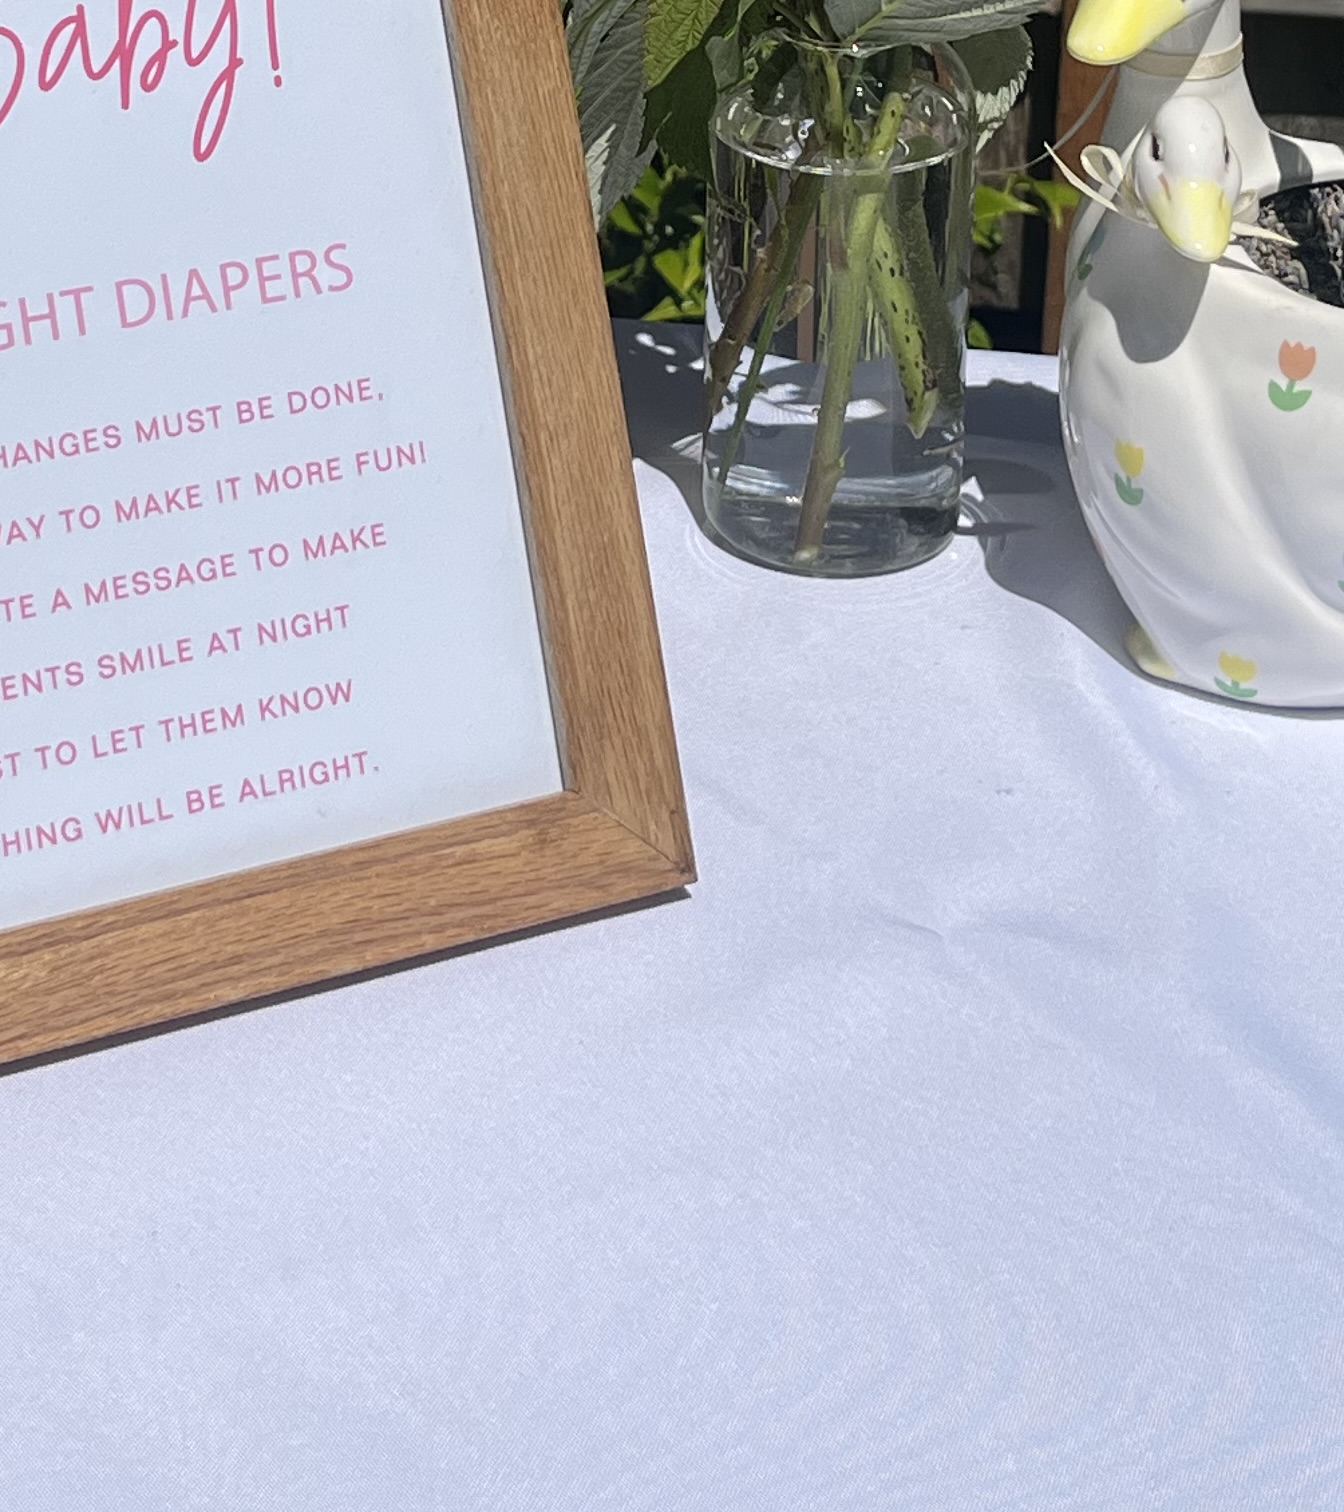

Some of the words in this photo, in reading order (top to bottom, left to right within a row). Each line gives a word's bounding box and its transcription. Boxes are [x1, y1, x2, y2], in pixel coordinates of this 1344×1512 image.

[114, 242, 355, 330] DIAPERS
[134, 404, 222, 441] MUST
[235, 395, 274, 425] BE
[58, 504, 102, 533] TO
[113, 484, 202, 521] MAKE
[215, 476, 241, 503] IT
[254, 457, 342, 496] MORE
[50, 588, 72, 614] A
[83, 553, 238, 605] MESSAGE
[248, 543, 291, 570] TO
[301, 523, 387, 560] MAKE
[96, 637, 194, 681] SMILE
[207, 626, 242, 656] AT
[256, 604, 350, 645] NIGHT
[34, 740, 79, 769] TO
[90, 724, 145, 760] LET
[158, 703, 246, 741] THEM
[257, 680, 353, 720] KNOW
[95, 798, 173, 835] WILL
[185, 784, 224, 816] BE
[239, 751, 381, 802] ALRIGHT.
